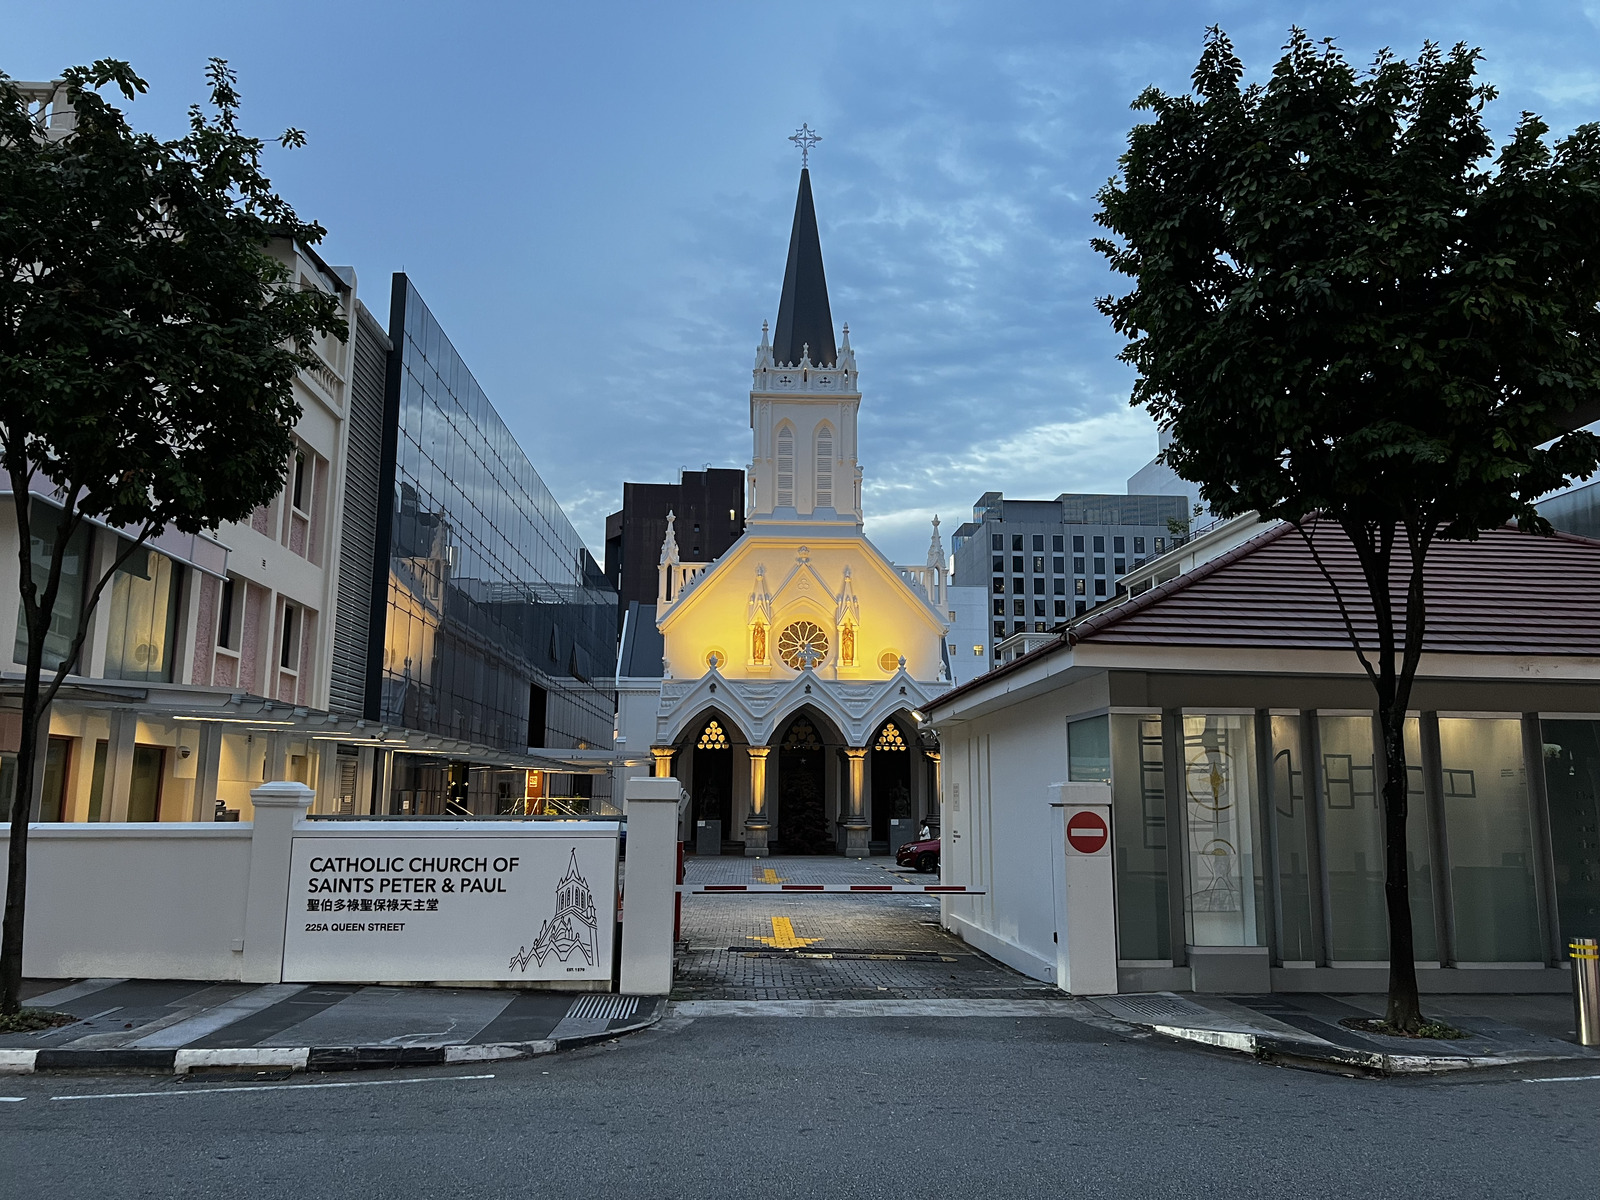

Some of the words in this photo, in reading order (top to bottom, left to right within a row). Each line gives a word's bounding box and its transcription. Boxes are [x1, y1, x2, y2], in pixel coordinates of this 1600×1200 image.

[309, 857, 405, 873] CATHOLIC
[408, 857, 488, 873] CHURCH
[493, 857, 520, 873] OF
[307, 877, 374, 893] SAINTS
[379, 877, 437, 893] PETER
[441, 877, 455, 893] &
[460, 877, 507, 893] PAUL
[305, 923, 329, 932] 225A
[331, 923, 365, 932] QUEEN
[368, 923, 406, 931] STREET
